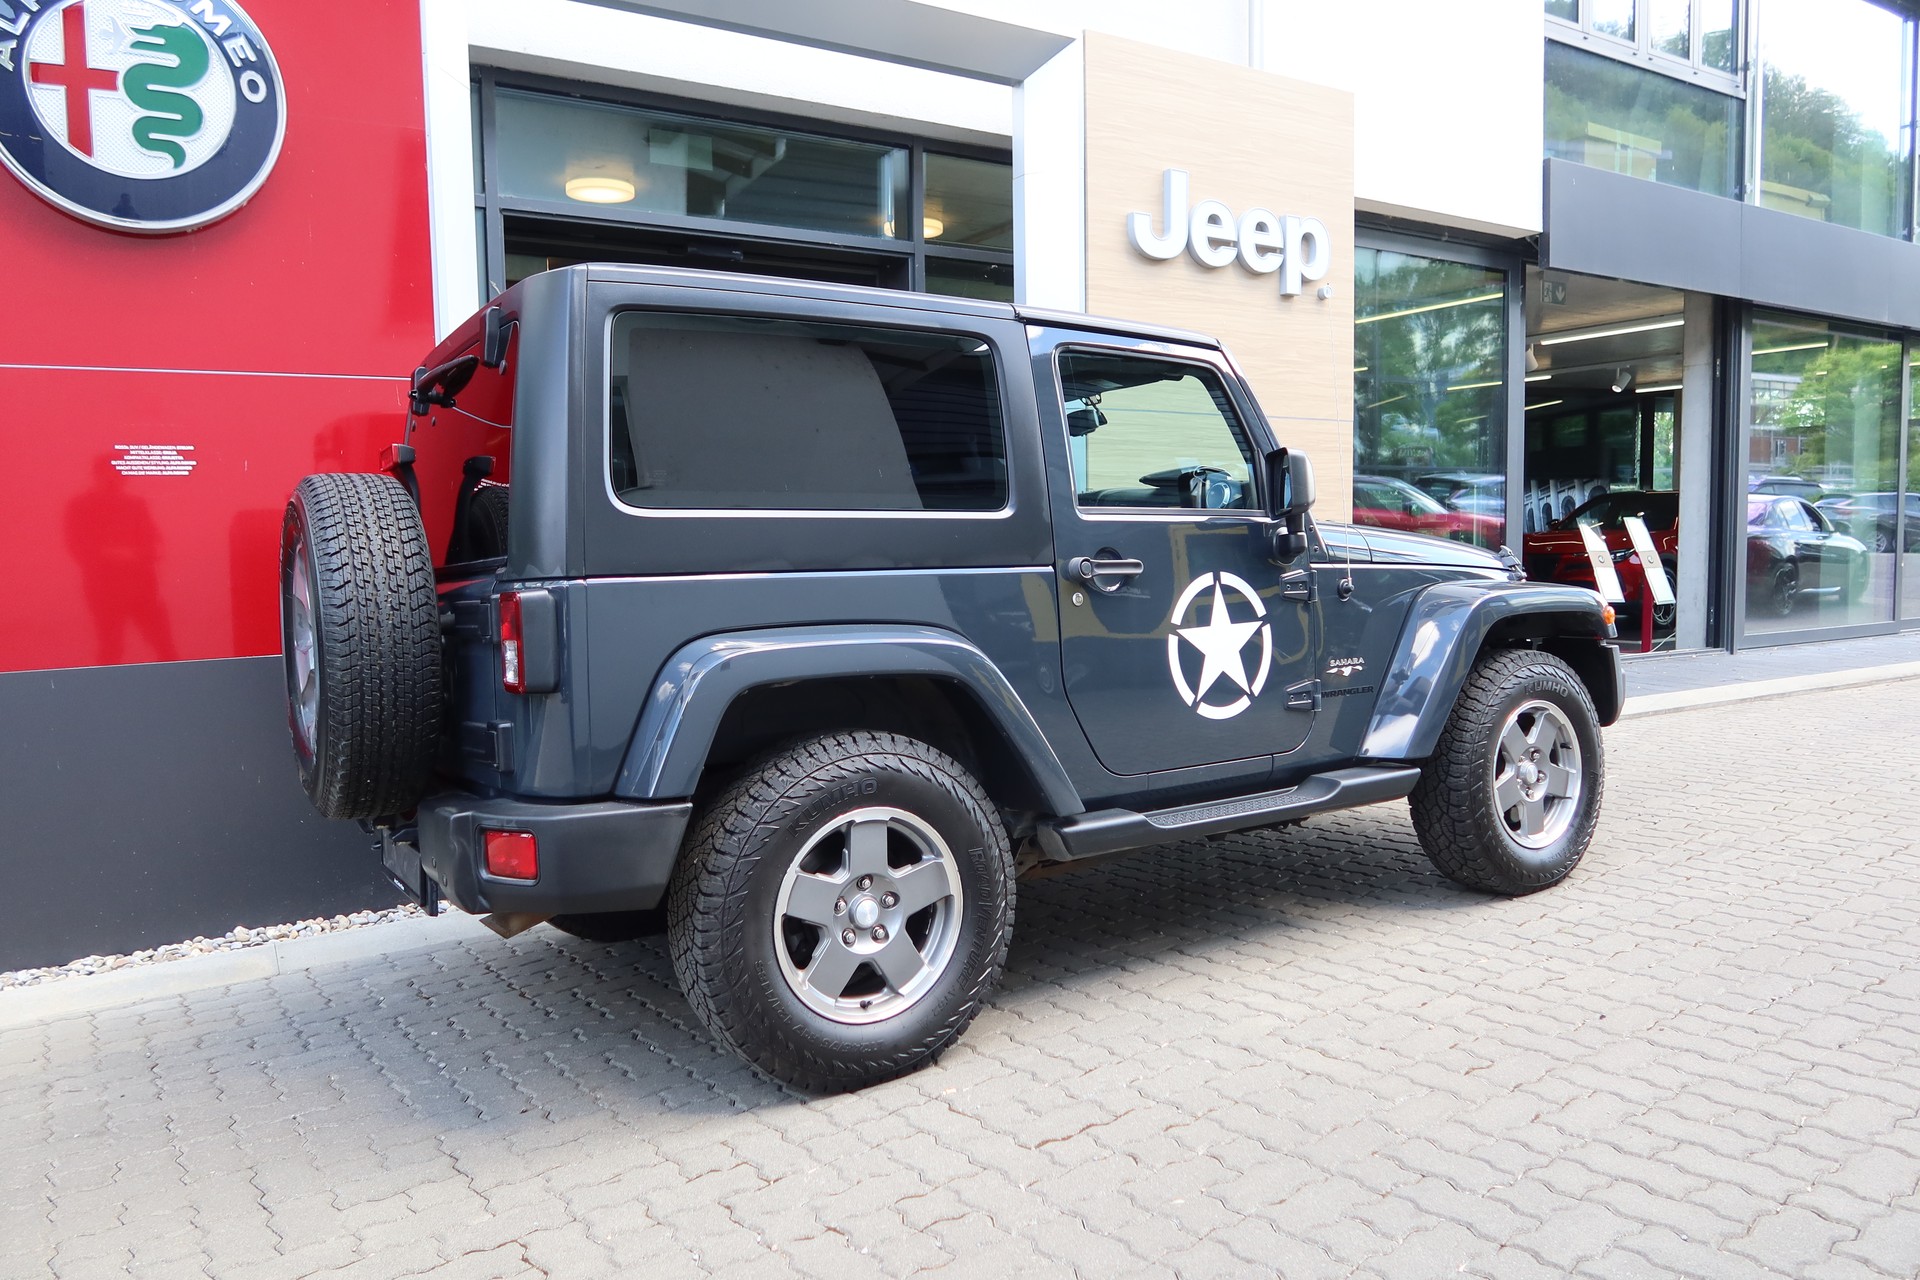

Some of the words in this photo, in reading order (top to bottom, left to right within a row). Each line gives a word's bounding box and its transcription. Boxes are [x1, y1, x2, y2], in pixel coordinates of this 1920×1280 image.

[174, 0, 267, 103] MEO
[1127, 168, 1332, 297] Jeep
[1329, 657, 1365, 667] SAHARA
[1321, 686, 1374, 698] WRANGLER
[1524, 680, 1569, 698] KUMHO
[786, 776, 879, 838] KUMHO
